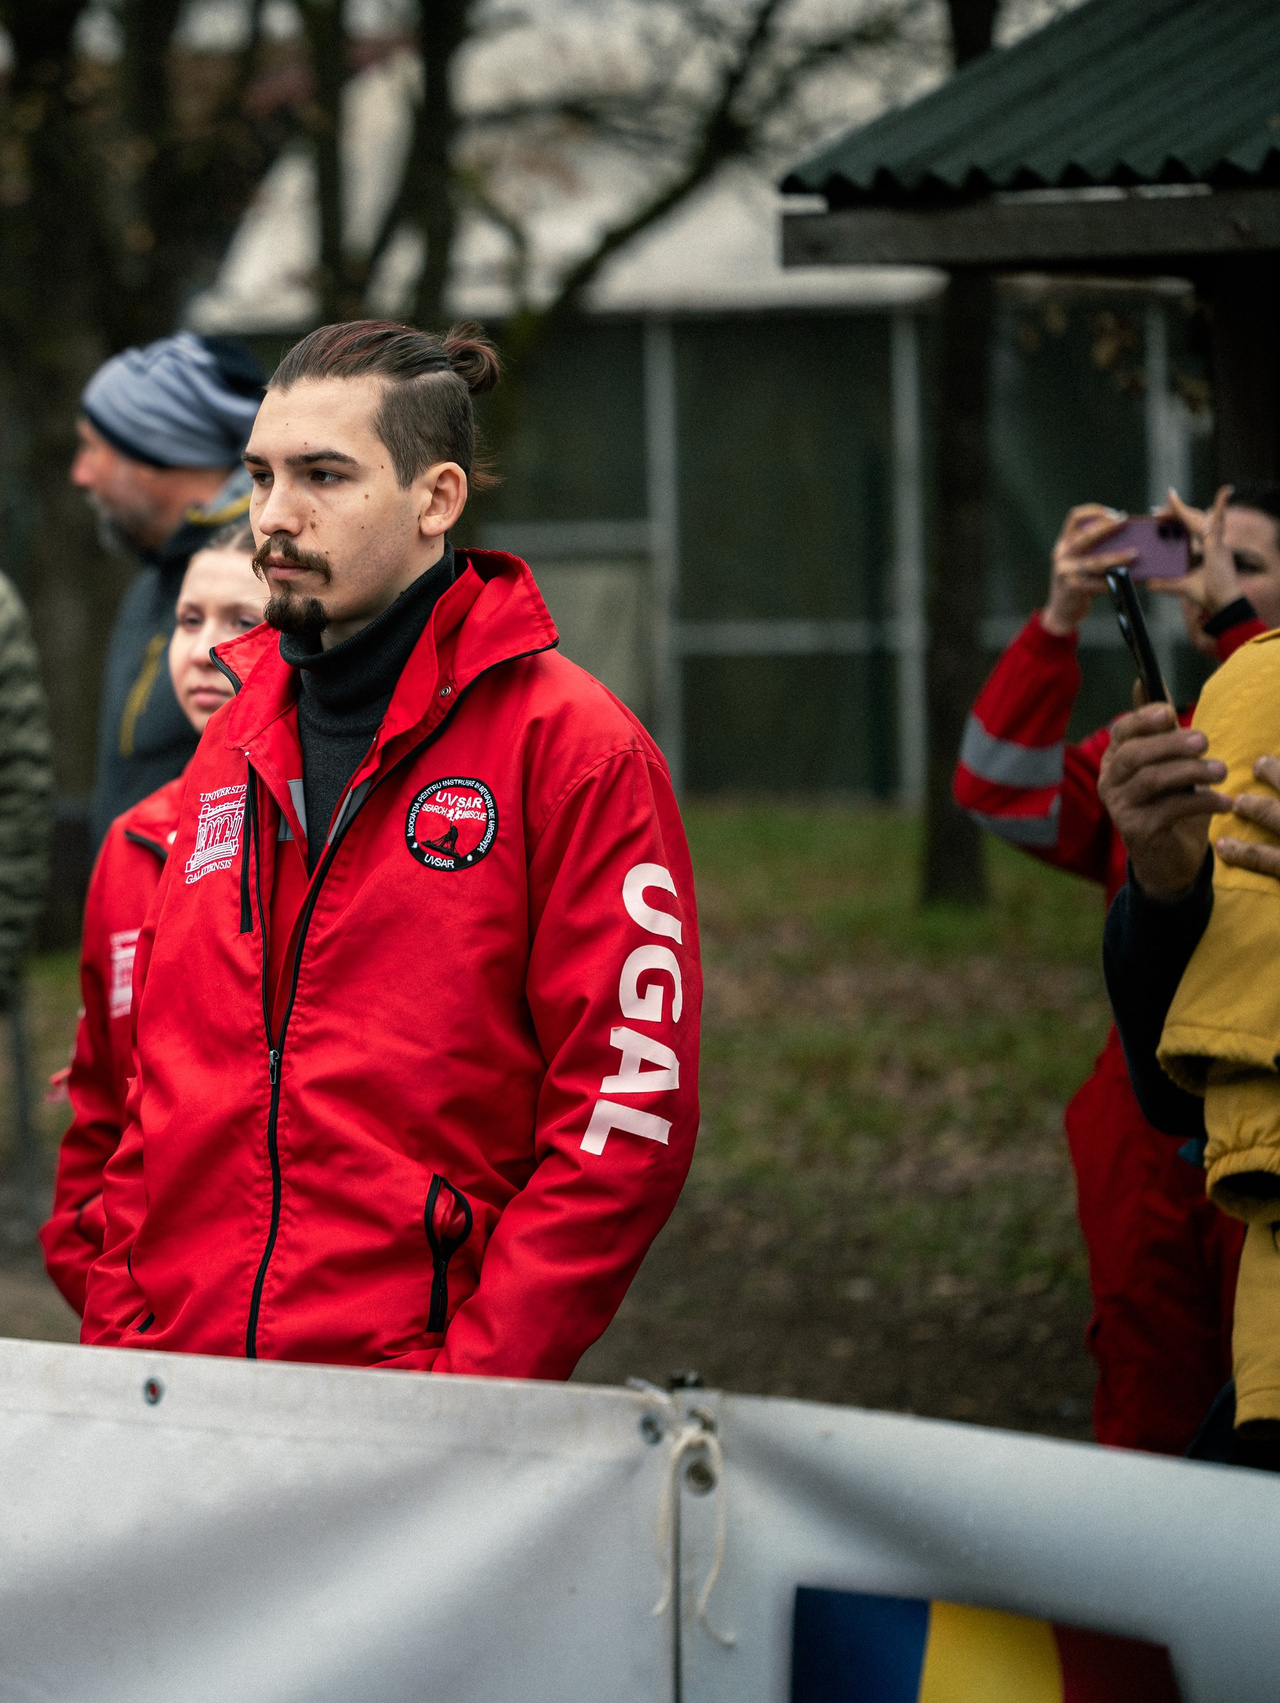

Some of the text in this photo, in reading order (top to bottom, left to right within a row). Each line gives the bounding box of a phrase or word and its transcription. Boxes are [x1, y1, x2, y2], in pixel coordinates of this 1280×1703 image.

[200, 784, 247, 802] UNIVERSITA
[417, 782, 441, 802] PENTRU
[435, 791, 484, 809] UVSAR
[421, 803, 448, 816] SEARCH
[424, 853, 455, 869] UVSAR
[580, 863, 683, 1156] UGAL
